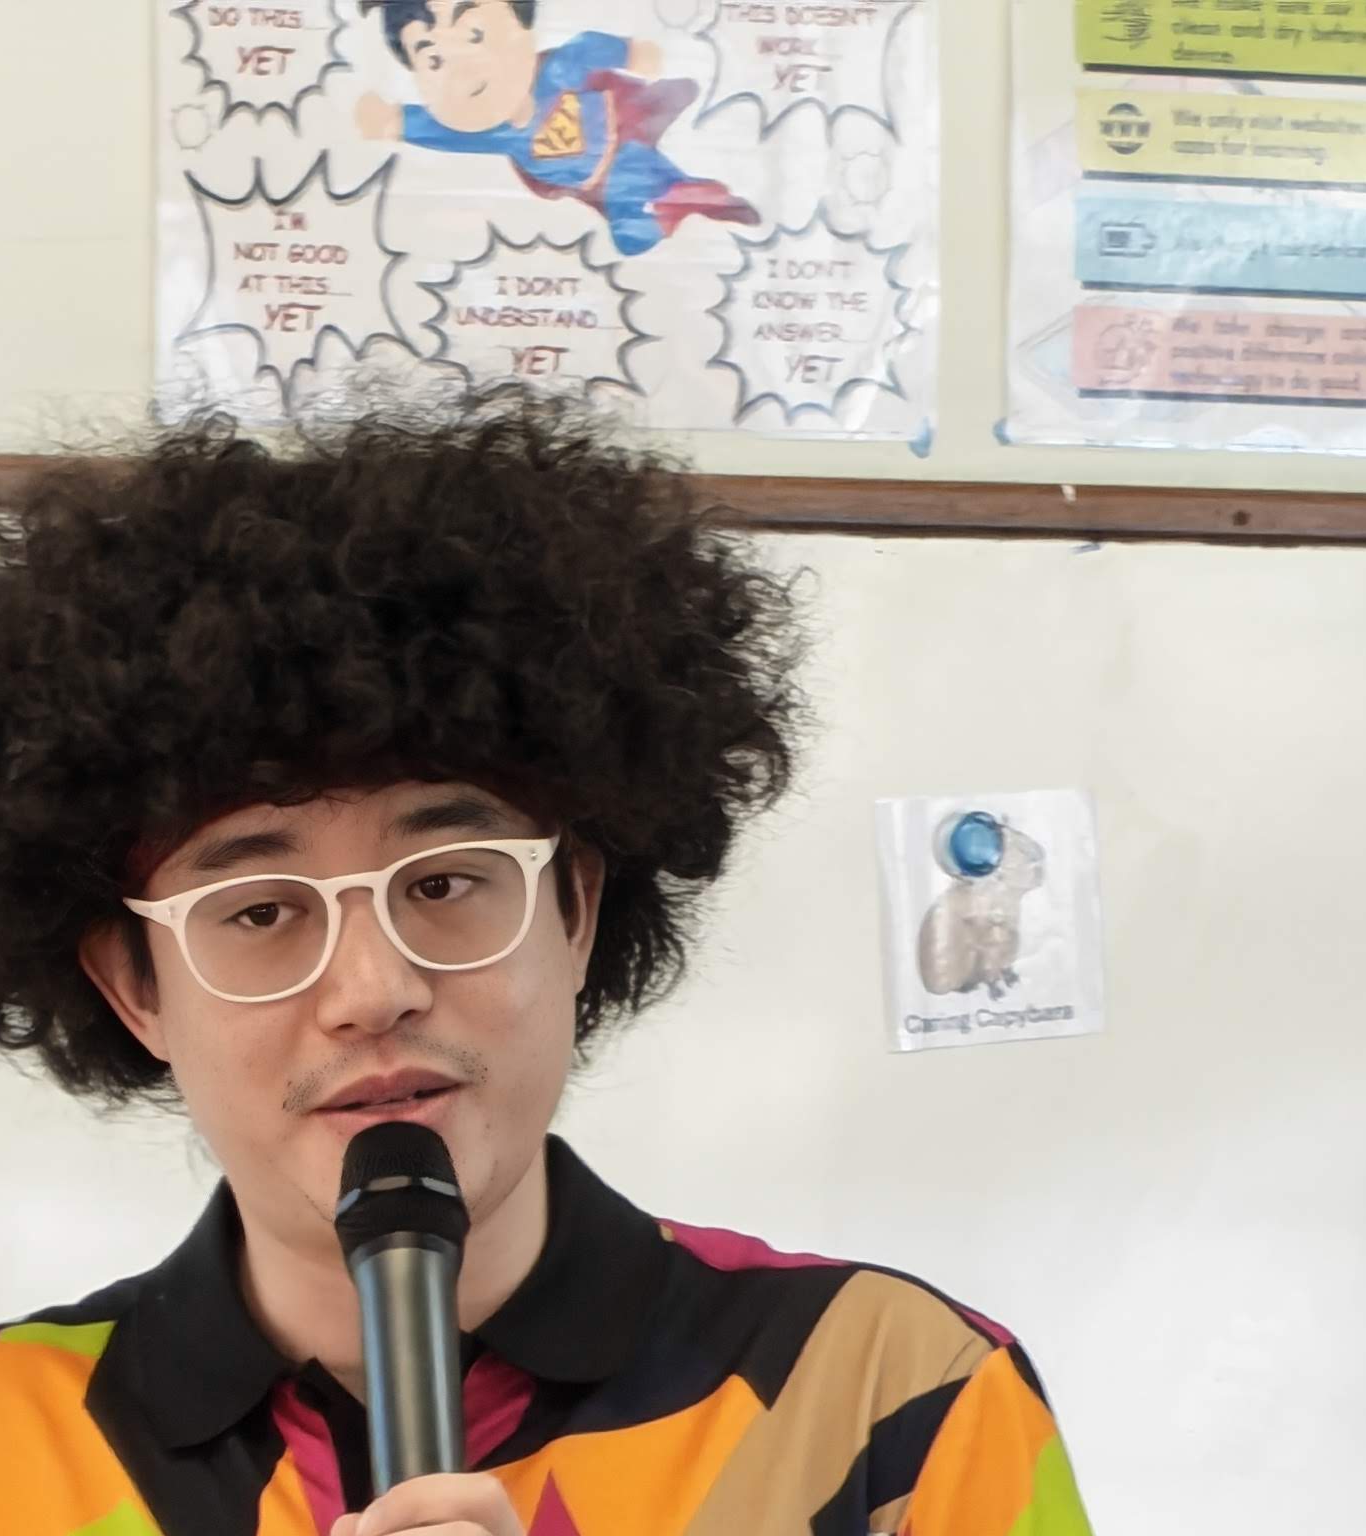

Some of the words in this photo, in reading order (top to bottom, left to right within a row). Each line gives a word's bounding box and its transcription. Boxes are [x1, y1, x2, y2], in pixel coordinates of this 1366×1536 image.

[235, 45, 296, 76] YET
[772, 63, 832, 93] YET
[233, 241, 281, 262] NOT
[286, 243, 349, 265] GOOD
[767, 258, 779, 279] I
[237, 274, 268, 293] AT
[496, 276, 508, 296] I
[515, 276, 582, 297] DON'T
[825, 291, 868, 313] THE
[264, 302, 324, 332] YET
[511, 345, 570, 376] YET
[784, 353, 845, 384] YET
